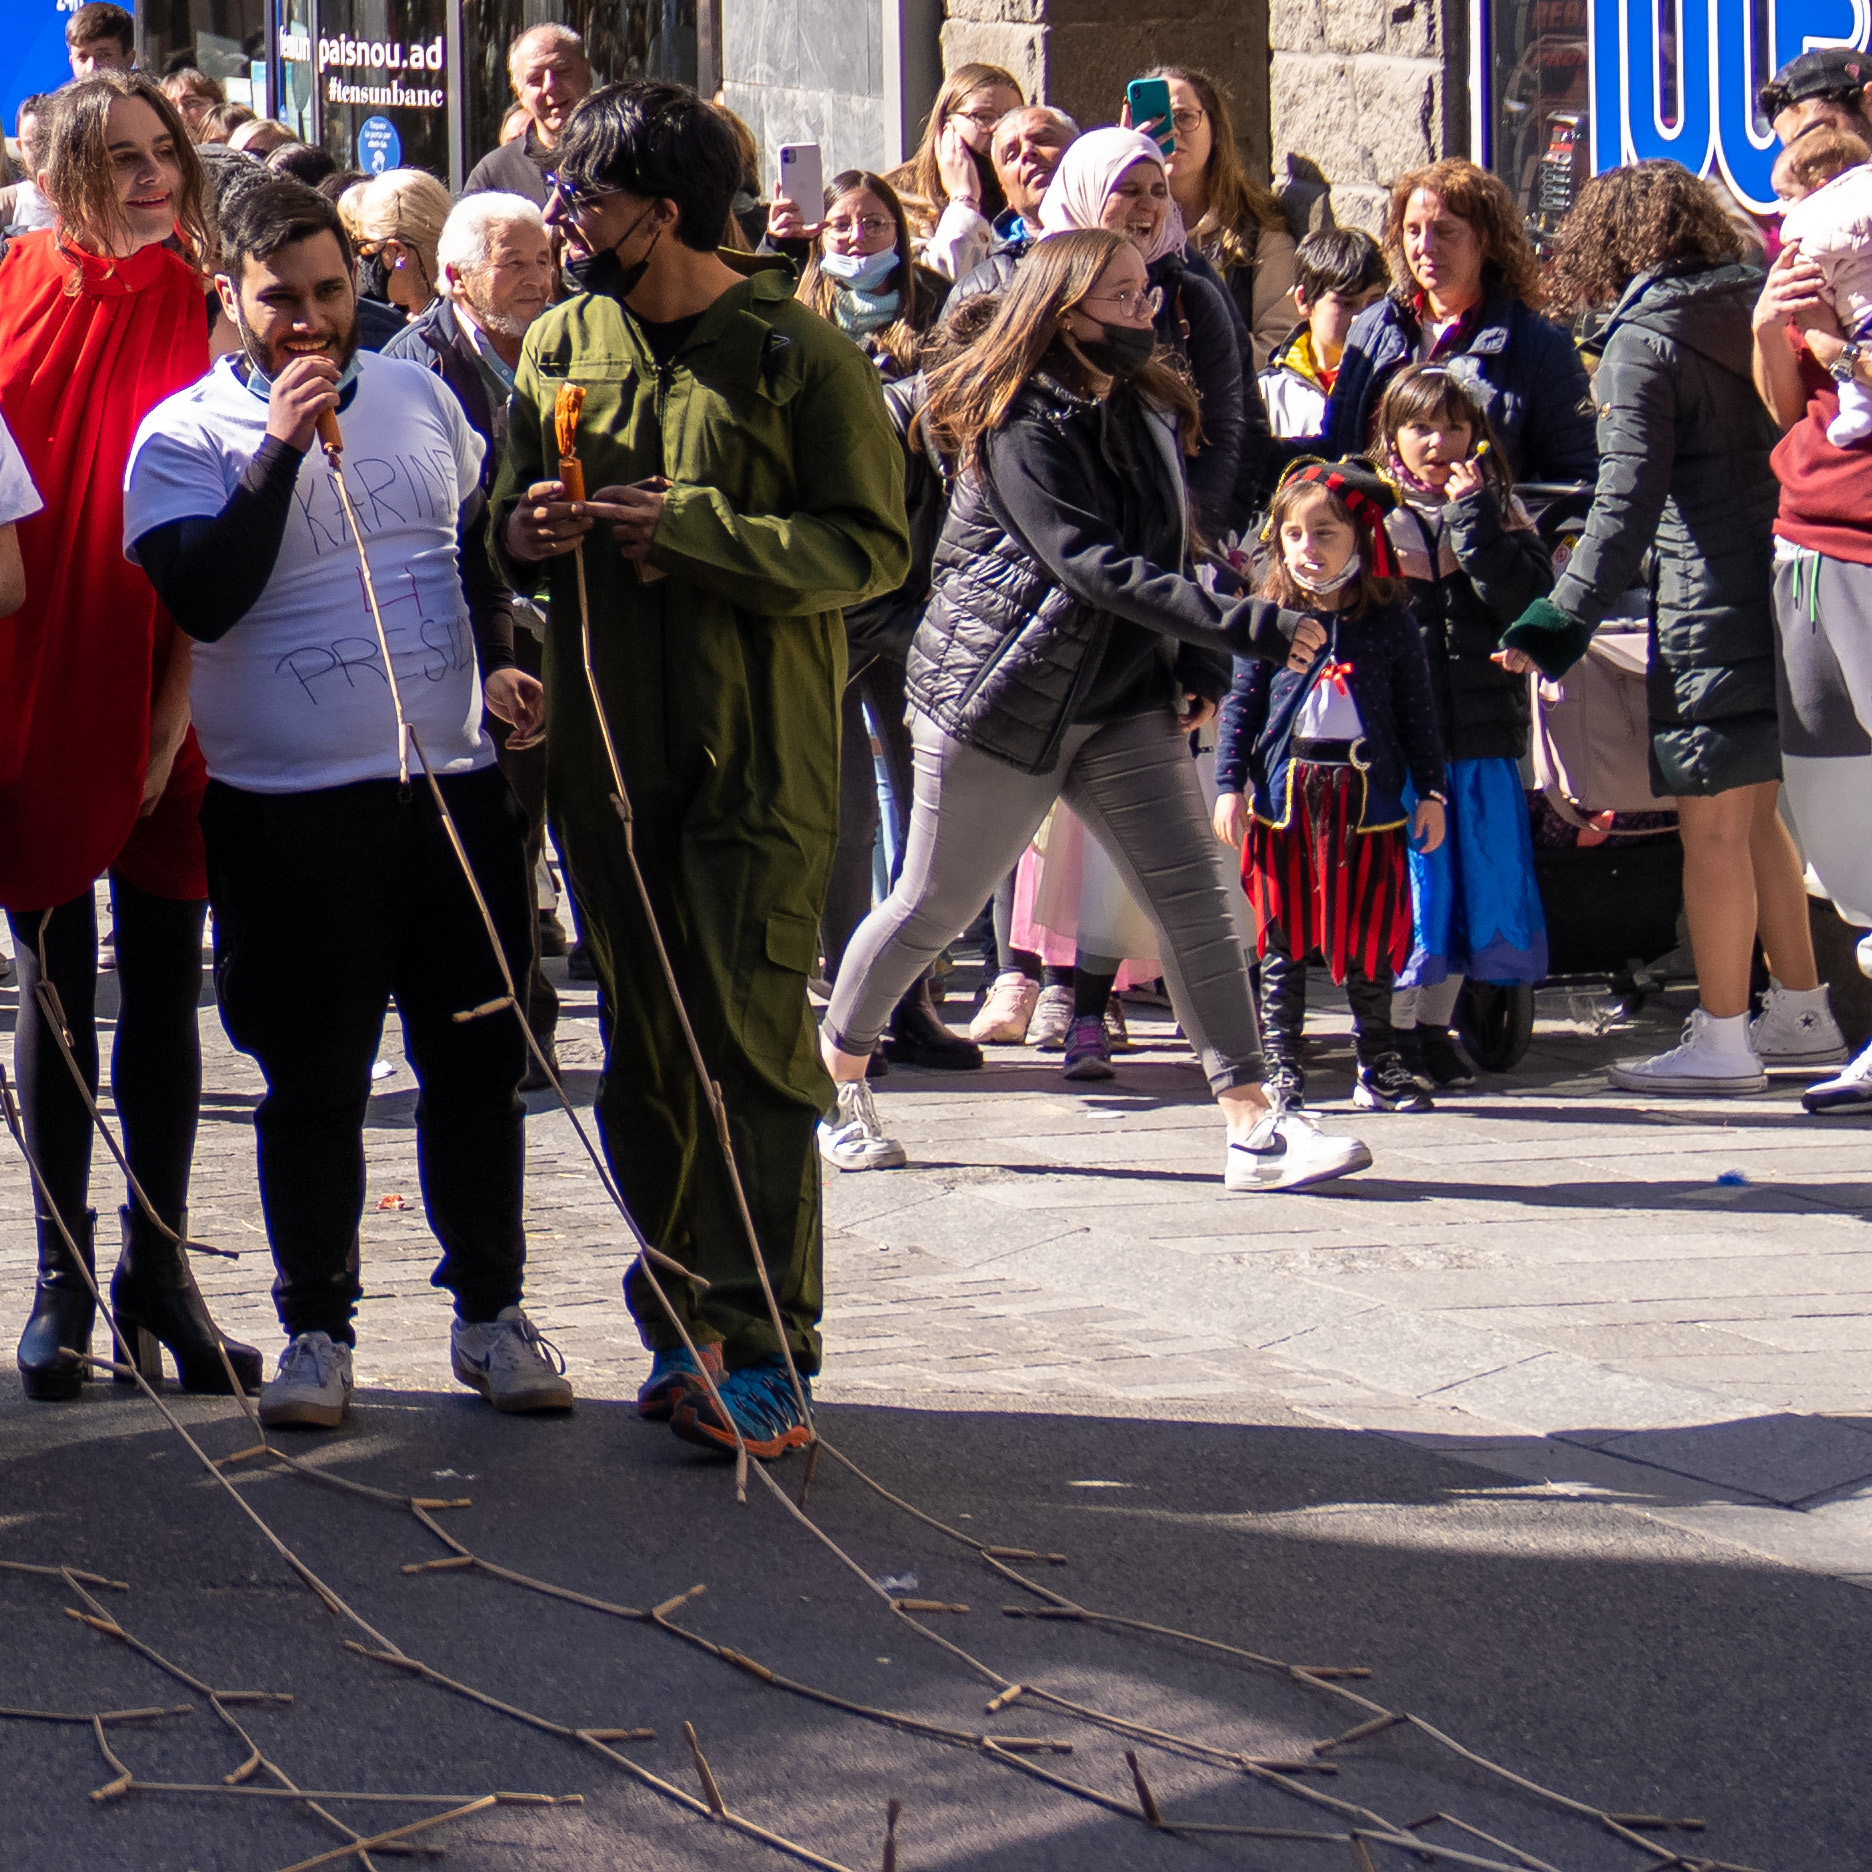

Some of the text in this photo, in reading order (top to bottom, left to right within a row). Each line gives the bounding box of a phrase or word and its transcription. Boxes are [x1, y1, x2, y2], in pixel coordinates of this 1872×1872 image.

[318, 32, 444, 73] paisnou.ad
[328, 76, 444, 108] #tensunbanc
[293, 447, 456, 556] KARINE
